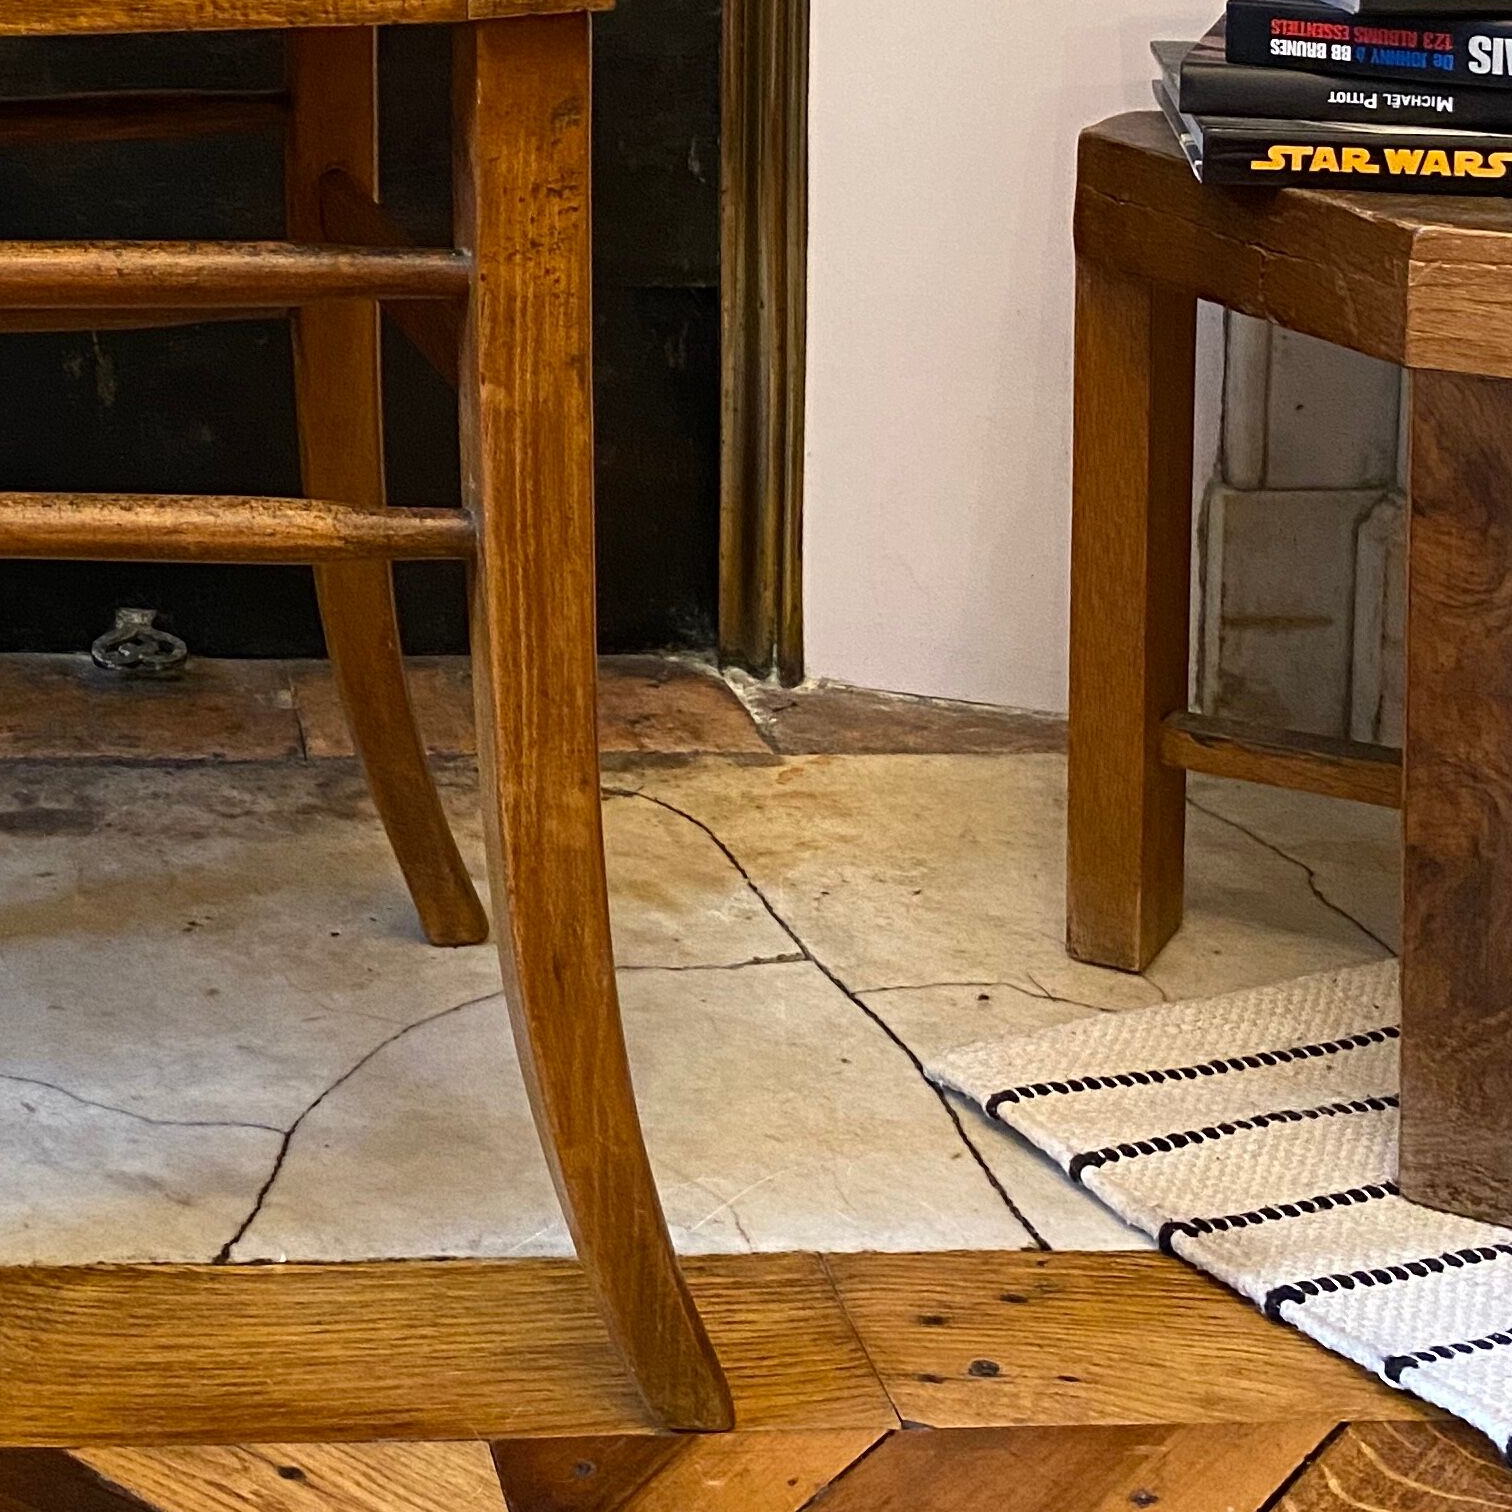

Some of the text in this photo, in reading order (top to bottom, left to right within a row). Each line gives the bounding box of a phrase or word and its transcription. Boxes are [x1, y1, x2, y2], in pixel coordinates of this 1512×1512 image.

[1270, 18, 1455, 52] 123 ALBUMS ESSENTIELS
[1270, 38, 1328, 60] BRUNES
[1330, 44, 1352, 62] BB
[1433, 53, 1455, 72] De
[1250, 144, 1512, 178] STAR WARS
